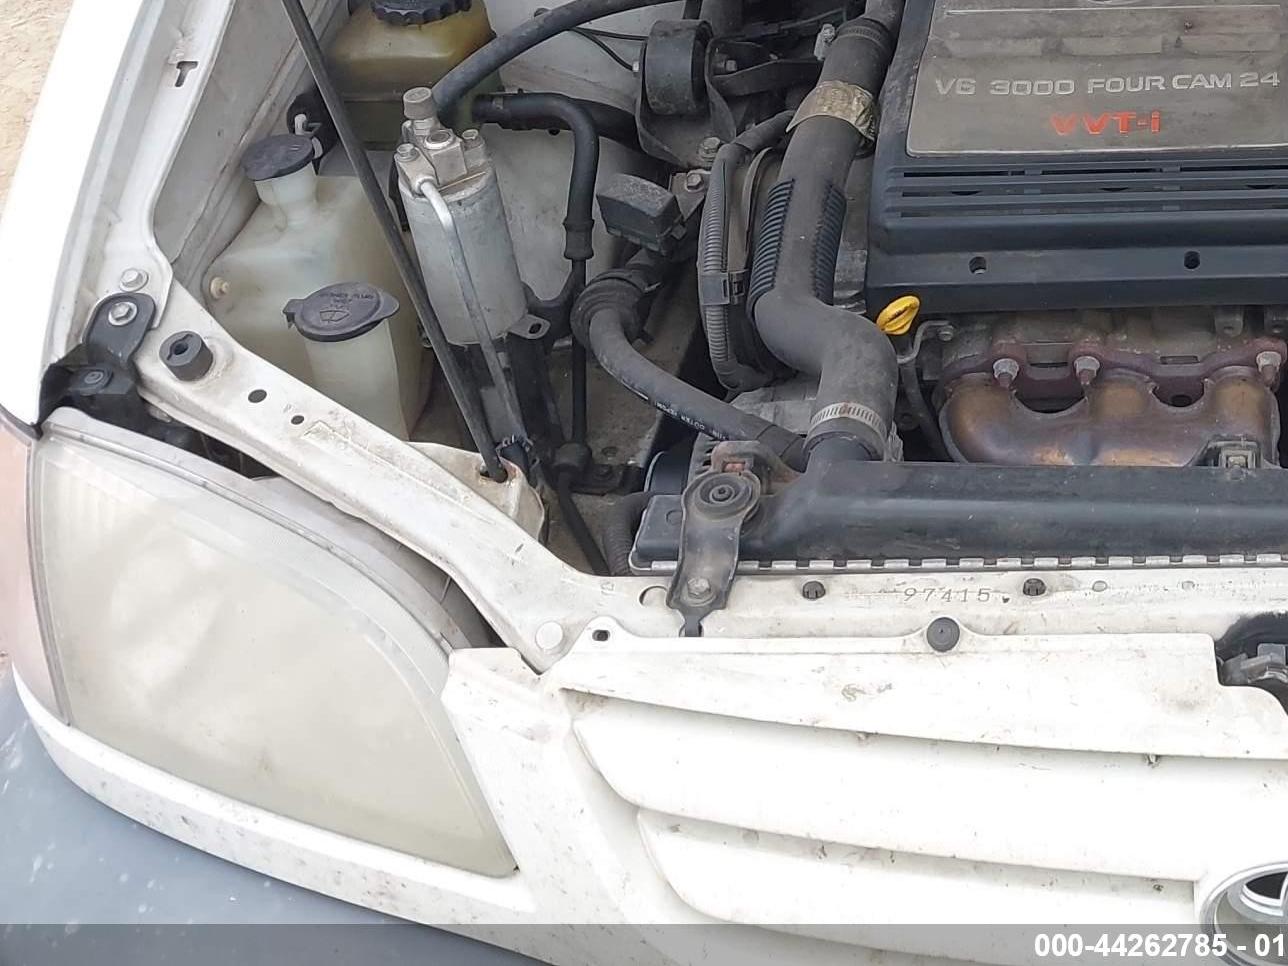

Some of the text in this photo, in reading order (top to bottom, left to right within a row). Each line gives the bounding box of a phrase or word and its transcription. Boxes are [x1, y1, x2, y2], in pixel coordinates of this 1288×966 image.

[935, 71, 1281, 96] V6 3000 FOUR CAM 24
[1050, 108, 1162, 136] VVT-i
[903, 587, 992, 603] 97415
